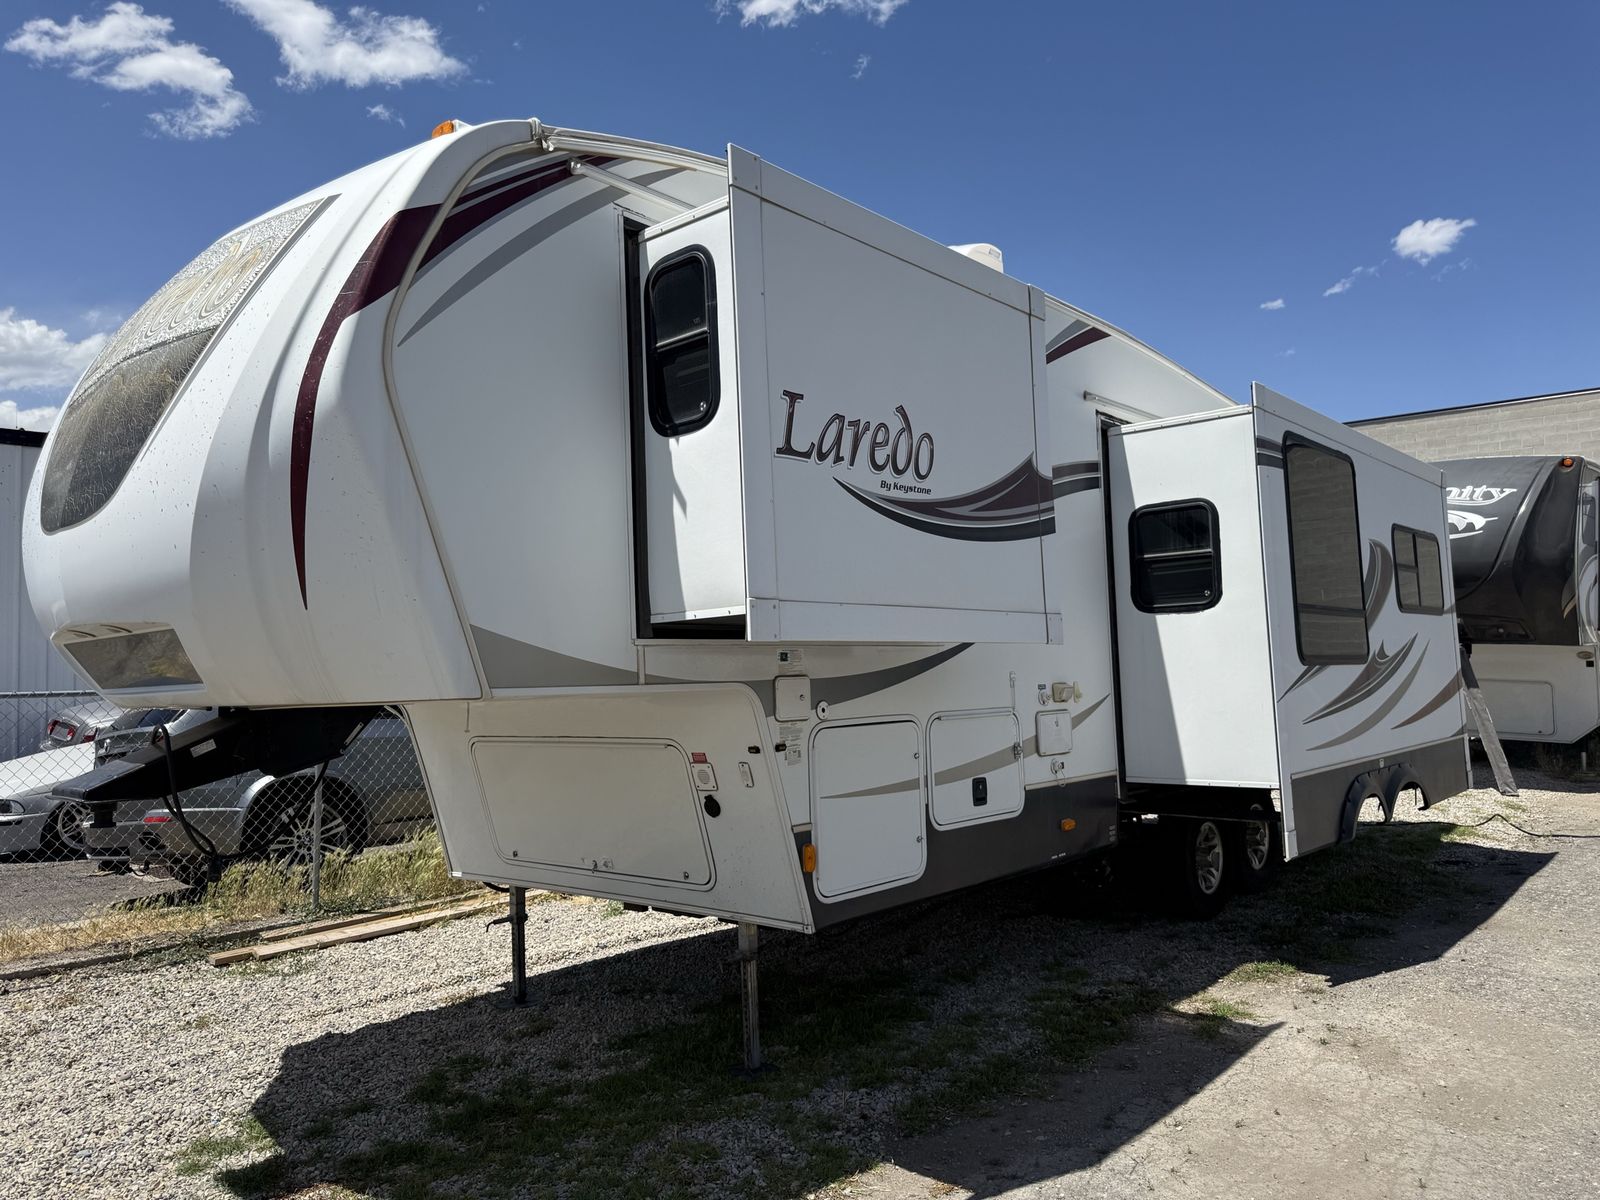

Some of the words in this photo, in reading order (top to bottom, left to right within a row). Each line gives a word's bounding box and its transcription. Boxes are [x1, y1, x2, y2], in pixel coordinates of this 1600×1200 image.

[775, 389, 934, 482] Laredo
[880, 480, 892, 491] By
[893, 482, 932, 495] Keystone
